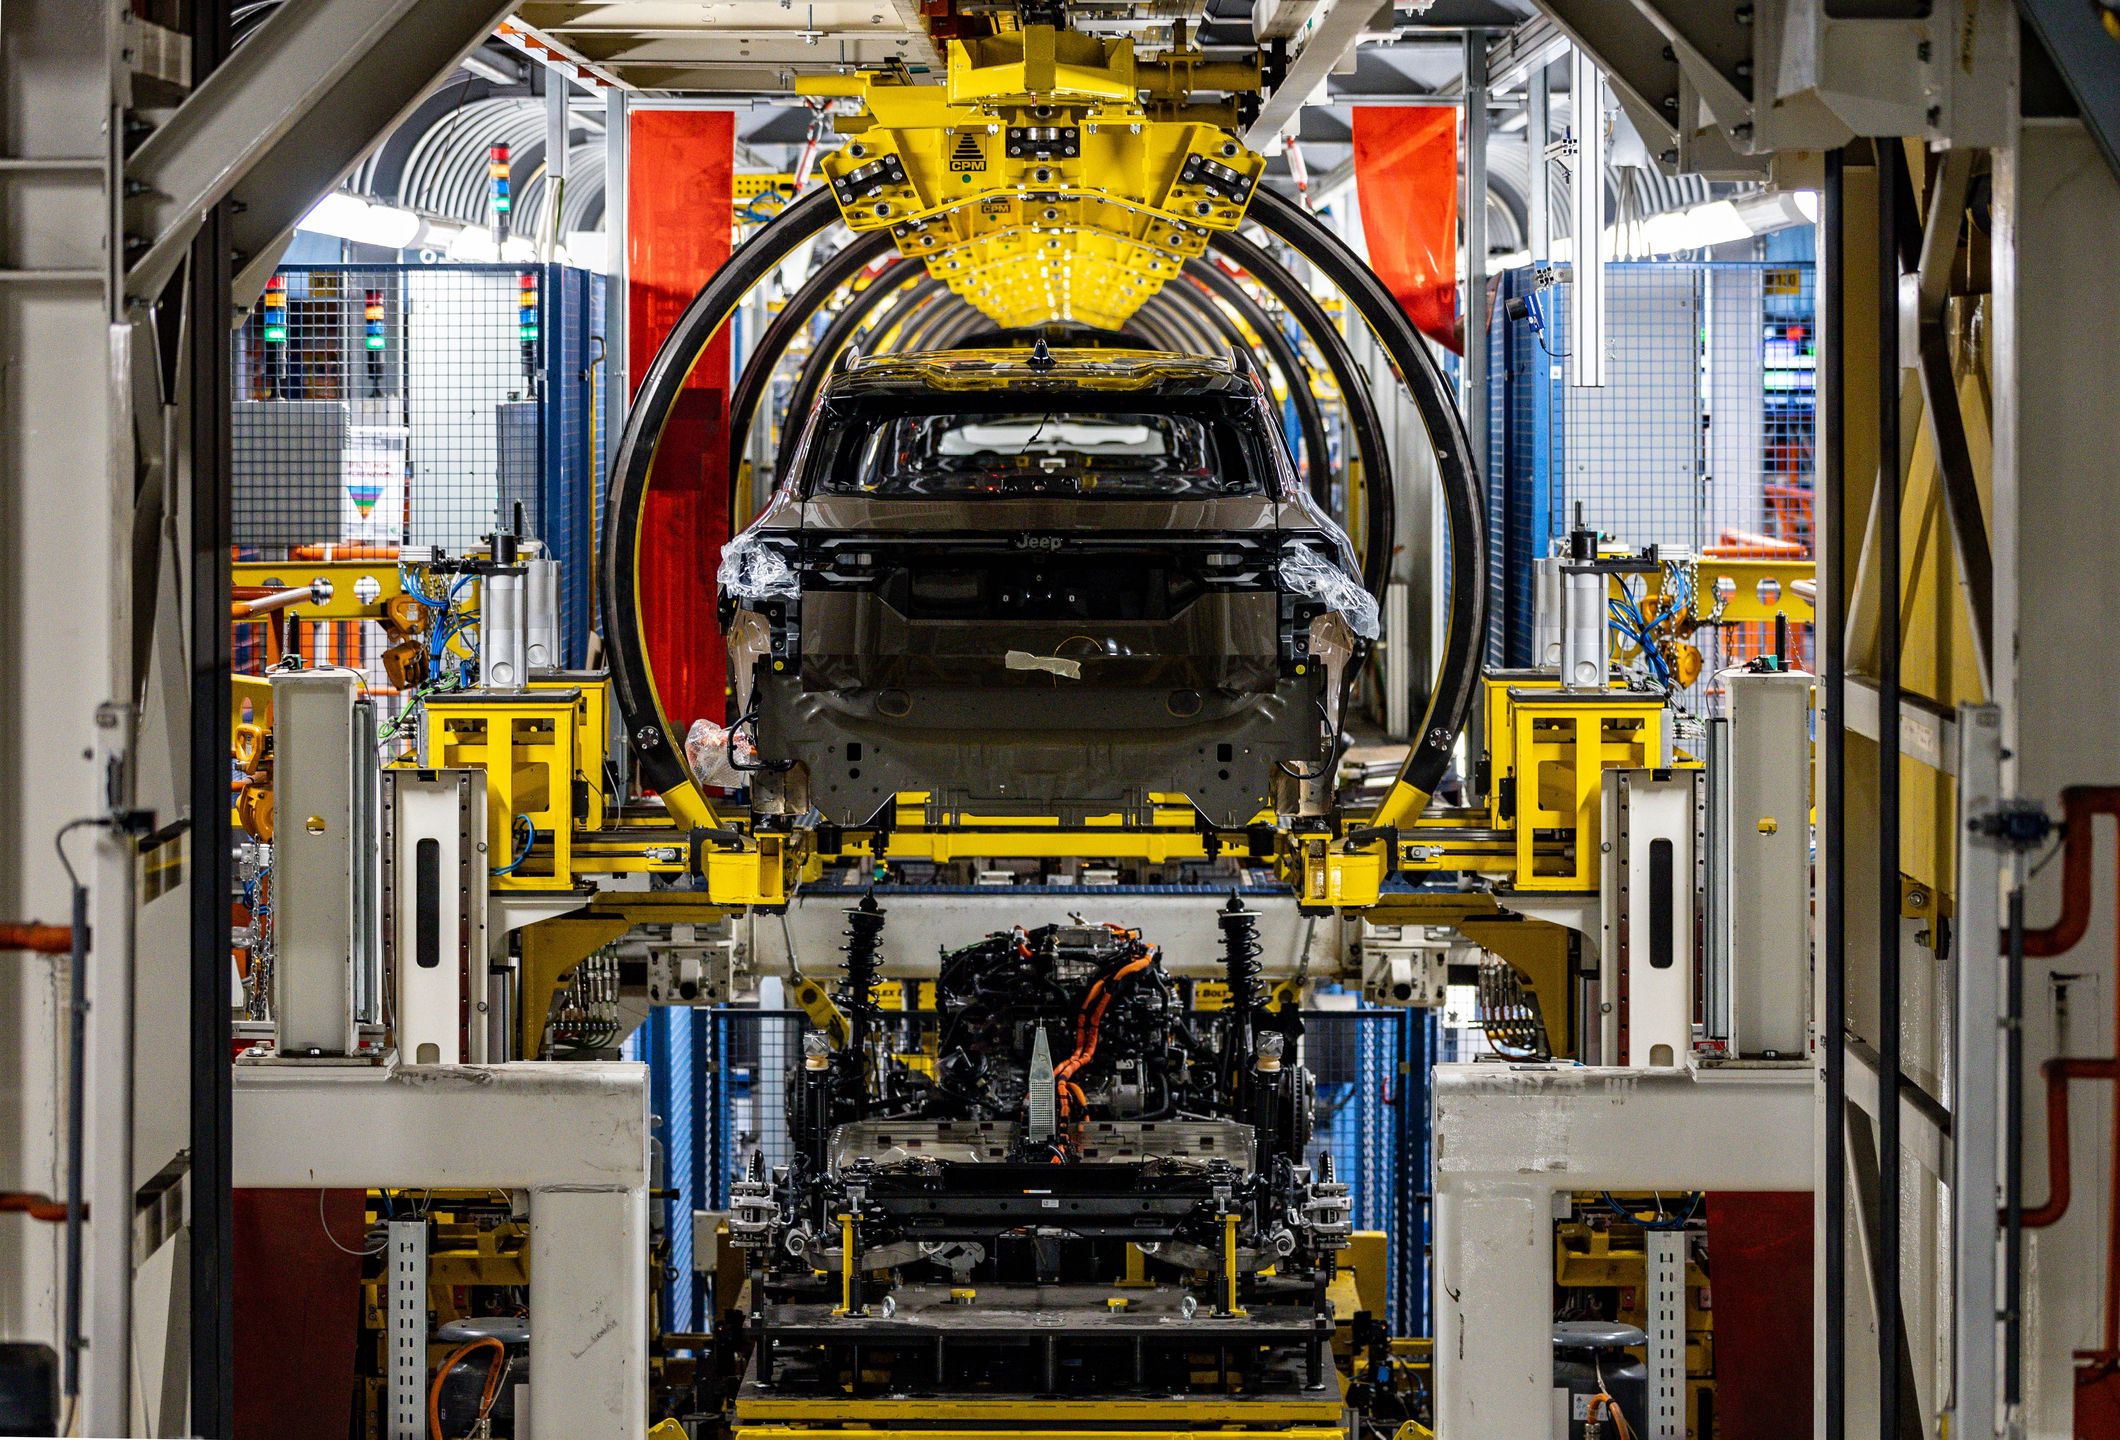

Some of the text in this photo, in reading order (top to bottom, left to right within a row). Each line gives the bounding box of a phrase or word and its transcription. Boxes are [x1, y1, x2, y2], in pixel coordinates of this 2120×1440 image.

[951, 162, 985, 171] CPM
[983, 205, 1009, 213] CPM
[1015, 534, 1061, 551] Jeep
